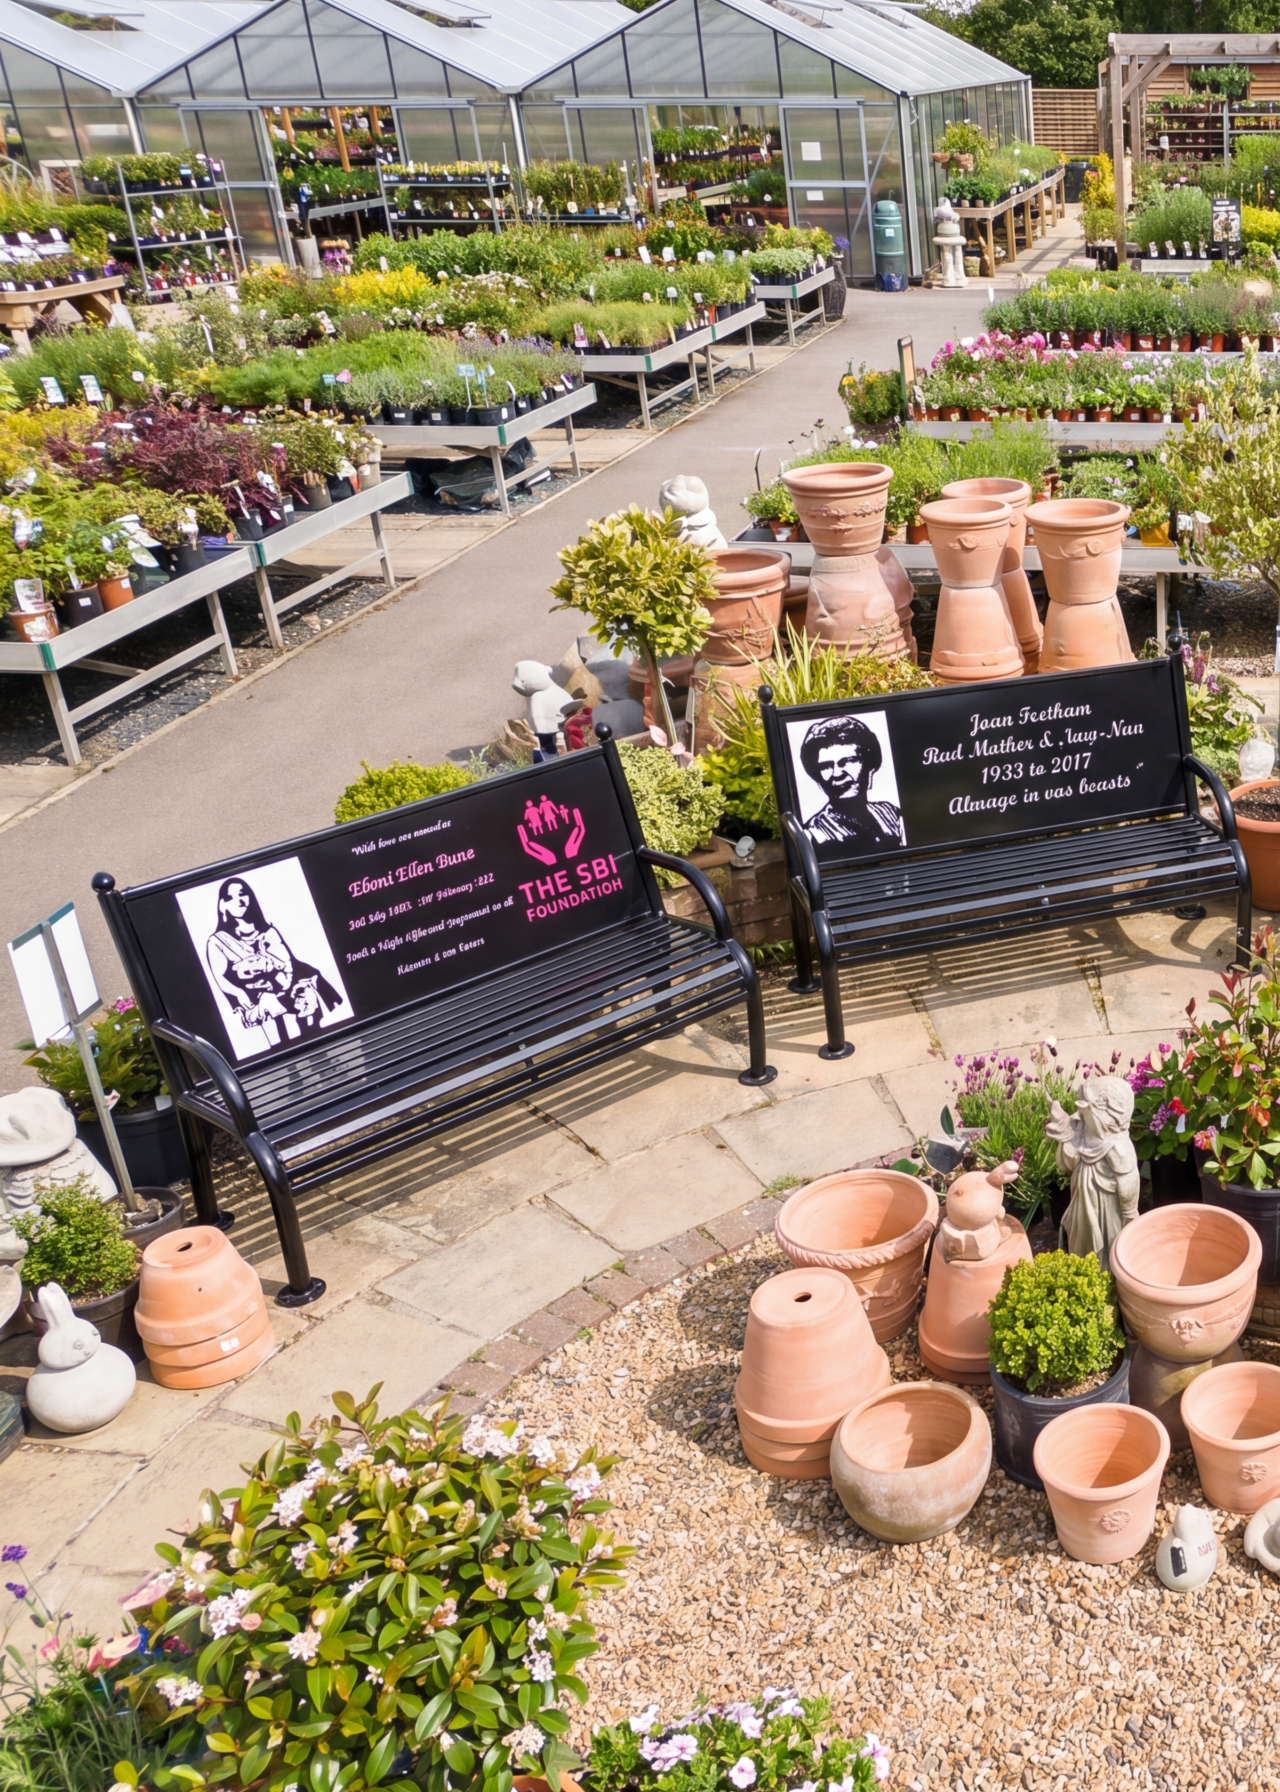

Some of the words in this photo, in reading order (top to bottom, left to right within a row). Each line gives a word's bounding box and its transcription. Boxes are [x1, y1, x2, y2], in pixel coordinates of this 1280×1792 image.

[970, 713, 1014, 737] Joan
[1019, 702, 1092, 724] Feetham
[968, 736, 1034, 759] Mather
[1039, 731, 1054, 749] &
[981, 762, 1024, 784] 1933
[1051, 752, 1092, 774] 2017
[1023, 788, 1040, 803] in
[349, 871, 394, 897] Eboni
[395, 861, 434, 882] Ellen
[518, 870, 572, 904] THE
[576, 854, 618, 885] SBI
